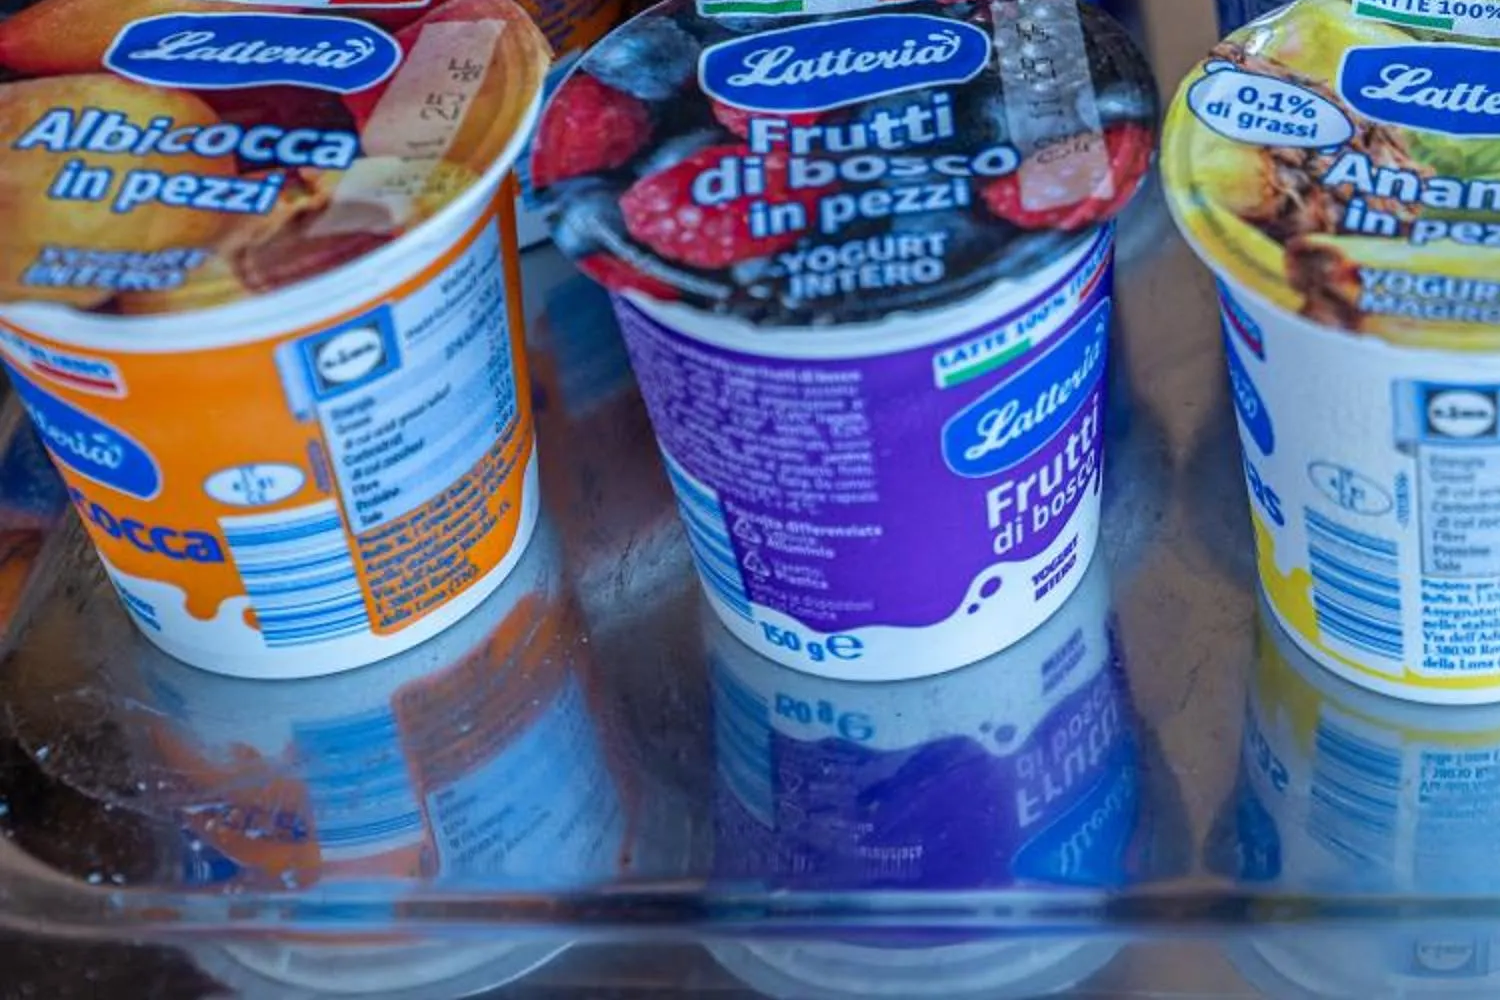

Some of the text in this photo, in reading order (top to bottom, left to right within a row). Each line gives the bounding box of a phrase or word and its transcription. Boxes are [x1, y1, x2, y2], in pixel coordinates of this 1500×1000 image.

[128, 30, 375, 70] Latteria
[727, 30, 962, 87] Latteria
[748, 93, 955, 154] Frutti
[1205, 96, 1319, 142] di grassi
[1236, 85, 1318, 121] 0,1%
[14, 107, 361, 170] Albicocca
[49, 159, 285, 214] in pezzi
[691, 145, 1020, 206] di bosco
[746, 178, 971, 239] in pezzi
[1342, 200, 1397, 237] in
[22, 264, 187, 290] INTERO
[779, 230, 950, 279] YOGURT
[787, 256, 948, 301] INTERO
[939, 330, 1007, 369] LATTE
[985, 393, 1101, 531] Frutti
[992, 447, 1097, 556] di bosco
[758, 620, 801, 653] 150
